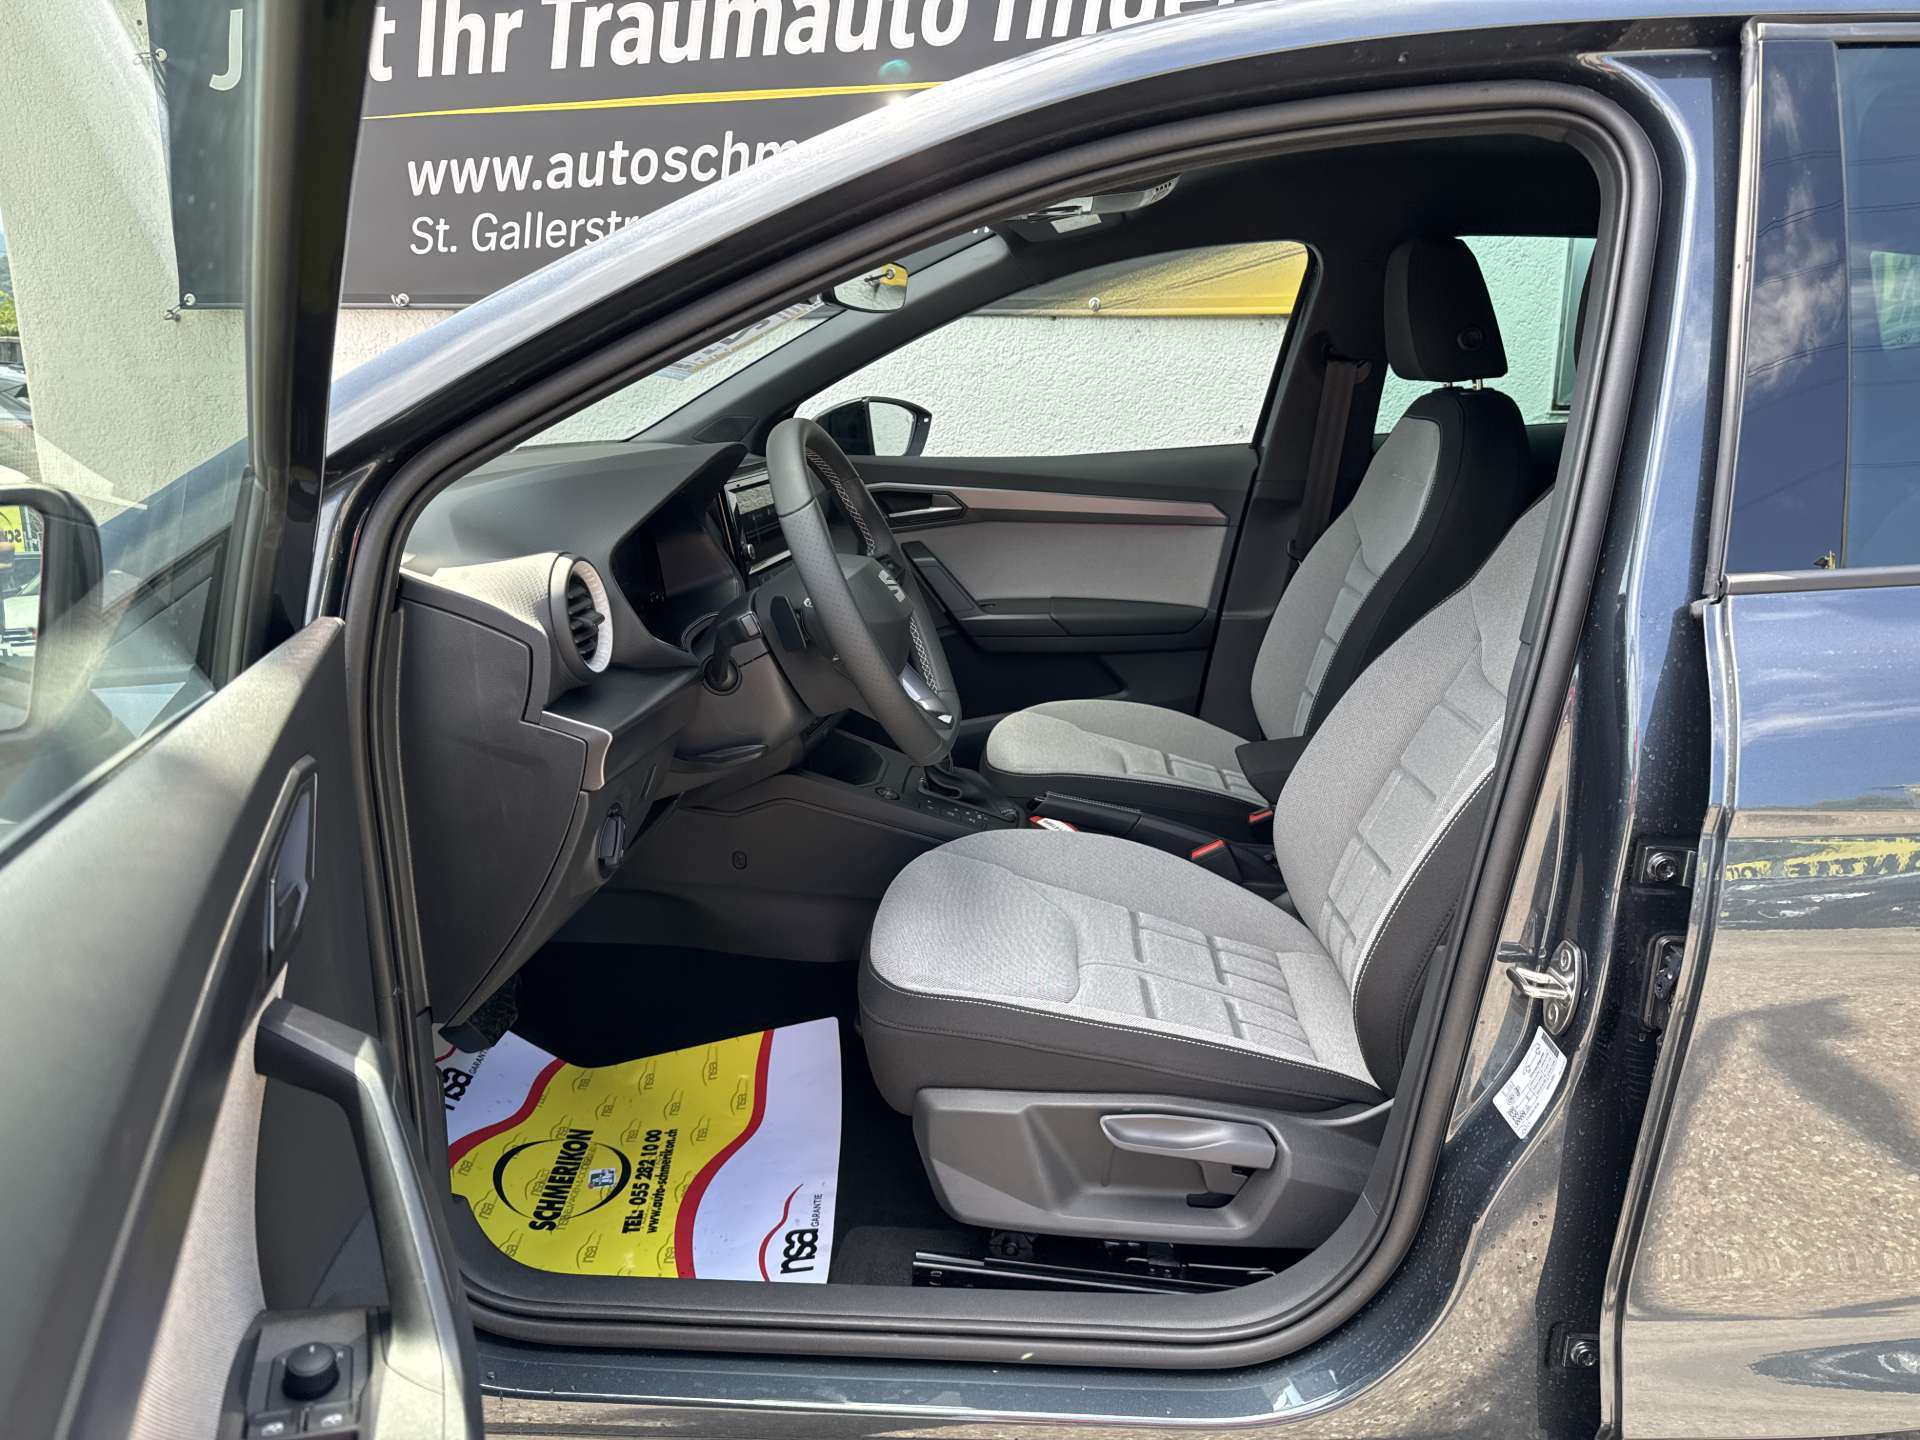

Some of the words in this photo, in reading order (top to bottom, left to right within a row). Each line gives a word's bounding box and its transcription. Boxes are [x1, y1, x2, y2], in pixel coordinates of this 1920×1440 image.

[417, 0, 524, 77] Ihr
[542, 0, 968, 69] Traumauto
[410, 215, 457, 255] St.
[640, 1143, 659, 1157] 10
[644, 1129, 662, 1143] 00
[528, 1128, 594, 1232] SCHMERIKON
[635, 1159, 657, 1181] 282
[646, 1128, 678, 1234] www.auto-schmerikon.ch
[628, 1182, 650, 1206] 055
[621, 1209, 644, 1234] TEL:
[780, 1228, 819, 1274] nsa
